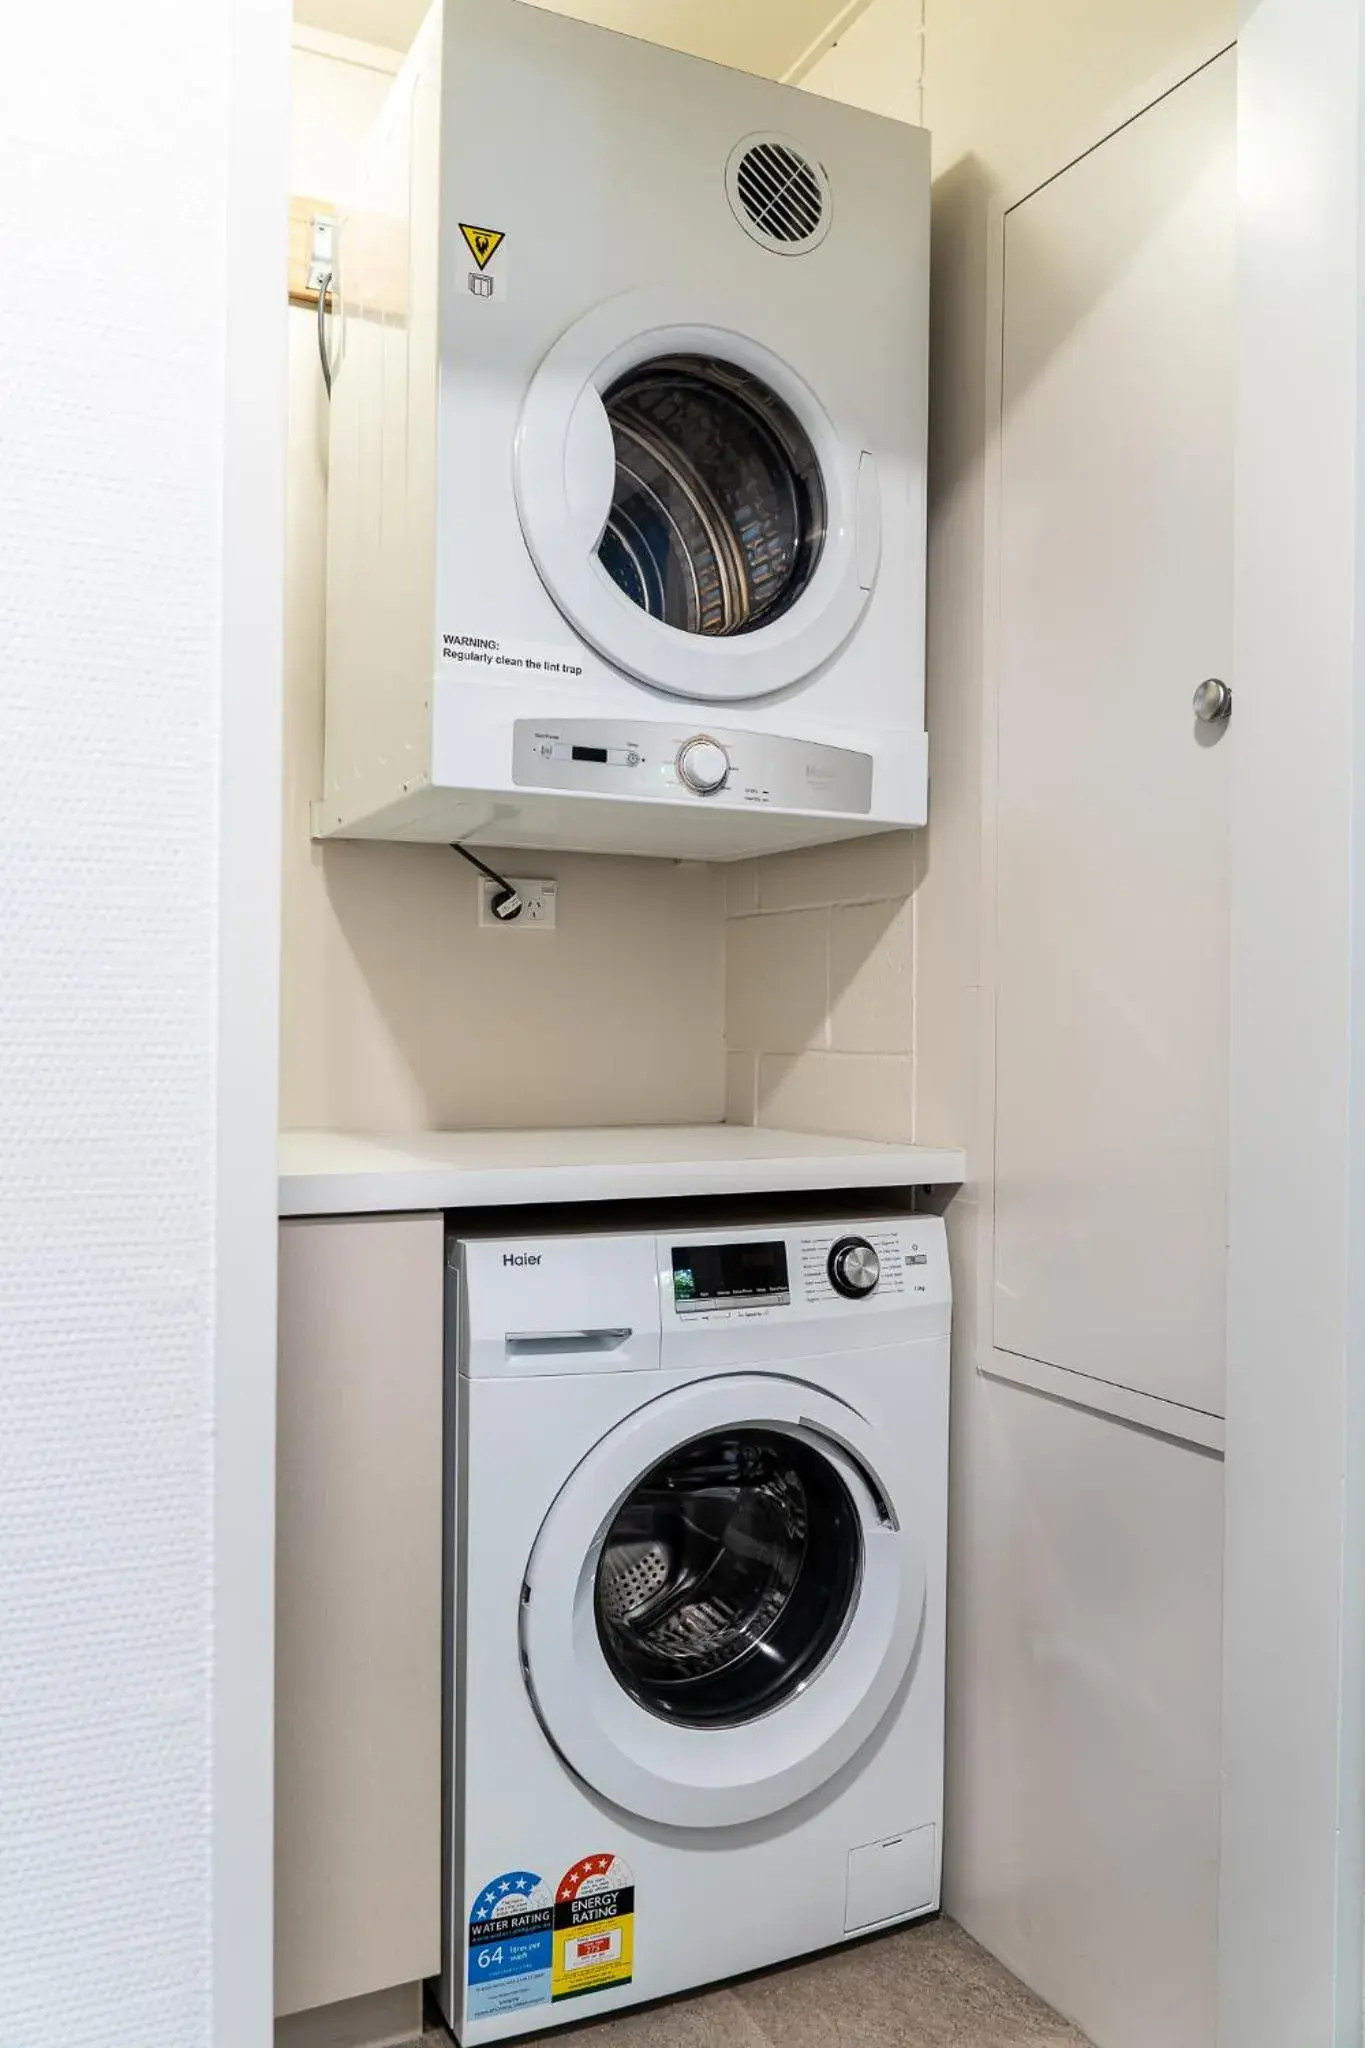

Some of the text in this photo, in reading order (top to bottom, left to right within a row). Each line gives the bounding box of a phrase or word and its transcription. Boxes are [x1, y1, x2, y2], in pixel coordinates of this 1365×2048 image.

[443, 634, 499, 650] WARNING:
[443, 648, 582, 676] Regularly clean the lint trap
[502, 1253, 542, 1267] Haier
[571, 1891, 619, 1913] ENERGY
[472, 1919, 509, 1935] WATER
[511, 1911, 550, 1927] RATING
[572, 1904, 618, 1924] RATING
[477, 1946, 504, 1968] 64
